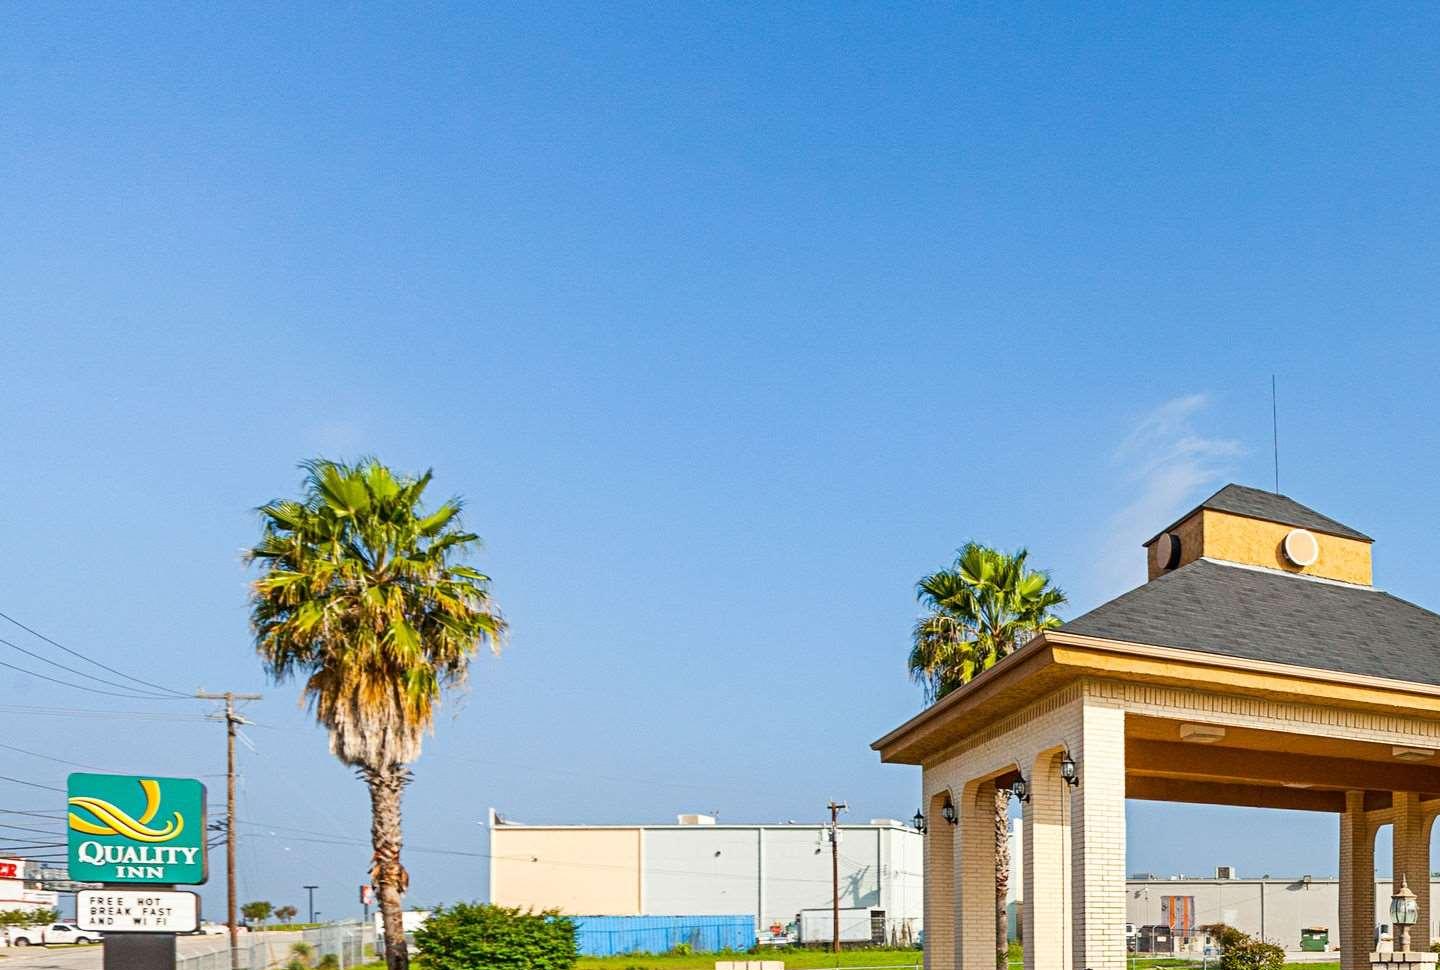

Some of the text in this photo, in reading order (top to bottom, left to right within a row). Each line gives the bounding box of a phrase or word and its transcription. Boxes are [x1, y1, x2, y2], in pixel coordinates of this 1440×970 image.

[78, 841, 200, 866] QUALITY
[116, 866, 164, 879] INN
[89, 897, 161, 906] FREE HOT
[90, 907, 172, 916] BREAK FAST
[89, 918, 114, 926] AND
